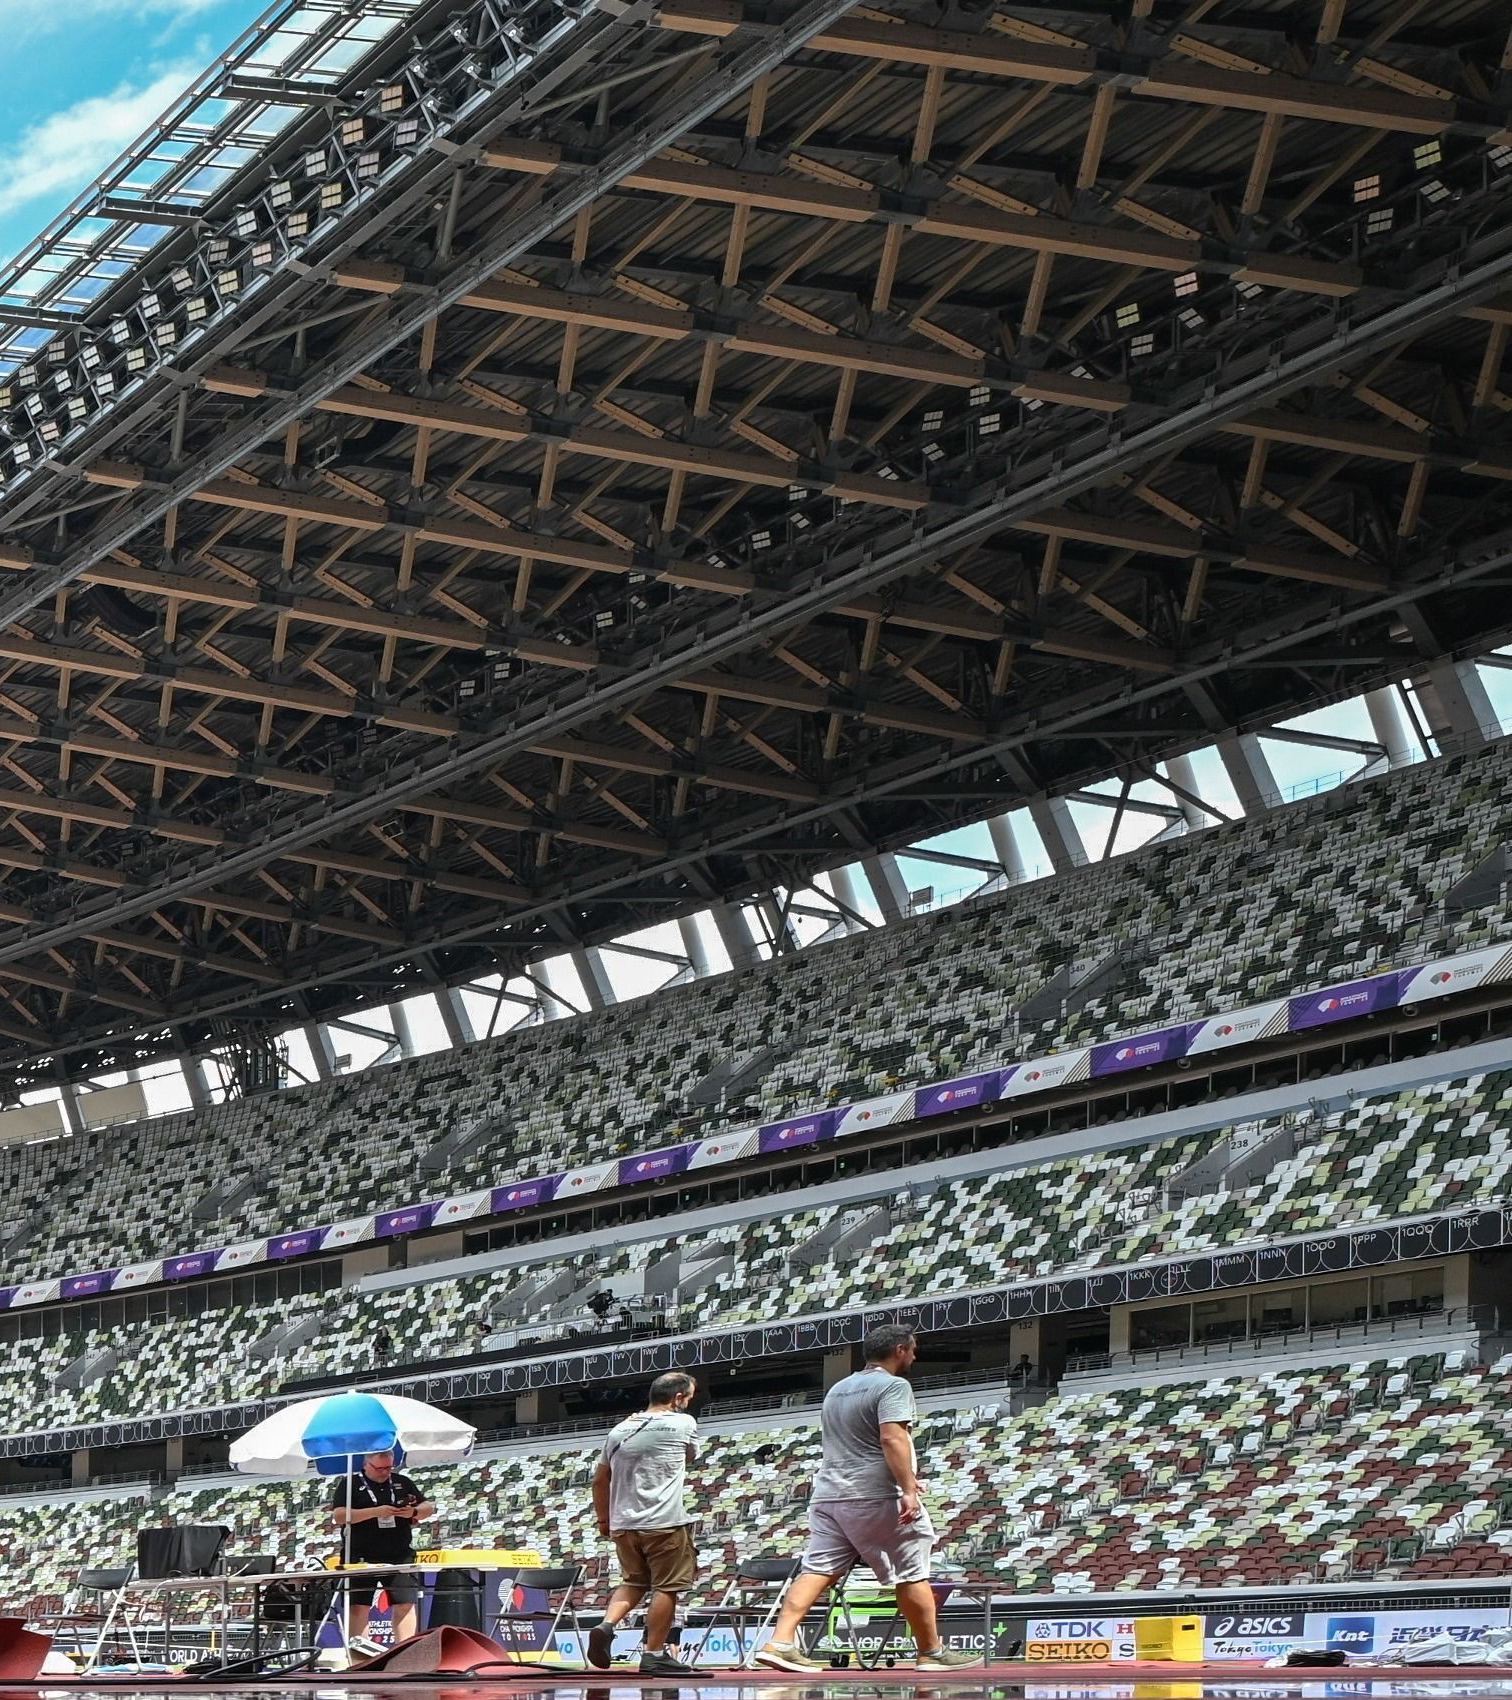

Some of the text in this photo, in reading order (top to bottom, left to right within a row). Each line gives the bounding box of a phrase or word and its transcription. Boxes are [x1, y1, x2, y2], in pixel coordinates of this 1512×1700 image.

[1231, 1139, 1249, 1150] 238
[841, 1216, 856, 1226] 239
[1453, 1216, 1479, 1229] 1RRR
[1402, 1224, 1434, 1238] 1QQQ
[1353, 1233, 1377, 1246] 1PPP
[1306, 1240, 1336, 1252] 1OOO
[1260, 1248, 1286, 1261] 1NNN
[1215, 1255, 1245, 1267] 1MMM
[1129, 1270, 1151, 1281] 1KKK
[1009, 1289, 1033, 1300] 1HHH
[972, 1295, 995, 1306] 1GGG
[866, 1312, 885, 1322] 1DDD
[899, 1308, 917, 1317] 1EEE
[798, 1323, 816, 1333] 1BBB
[831, 1317, 852, 1328] 1CCC
[1018, 1321, 1034, 1331] 132
[766, 1328, 783, 1337] 1AAA
[1051, 1621, 1106, 1638] TDK
[1239, 1616, 1293, 1635] asics
[1334, 1629, 1370, 1643] Knt
[162, 1648, 198, 1663] ORLD
[1028, 1642, 1110, 1661] SEIKO
